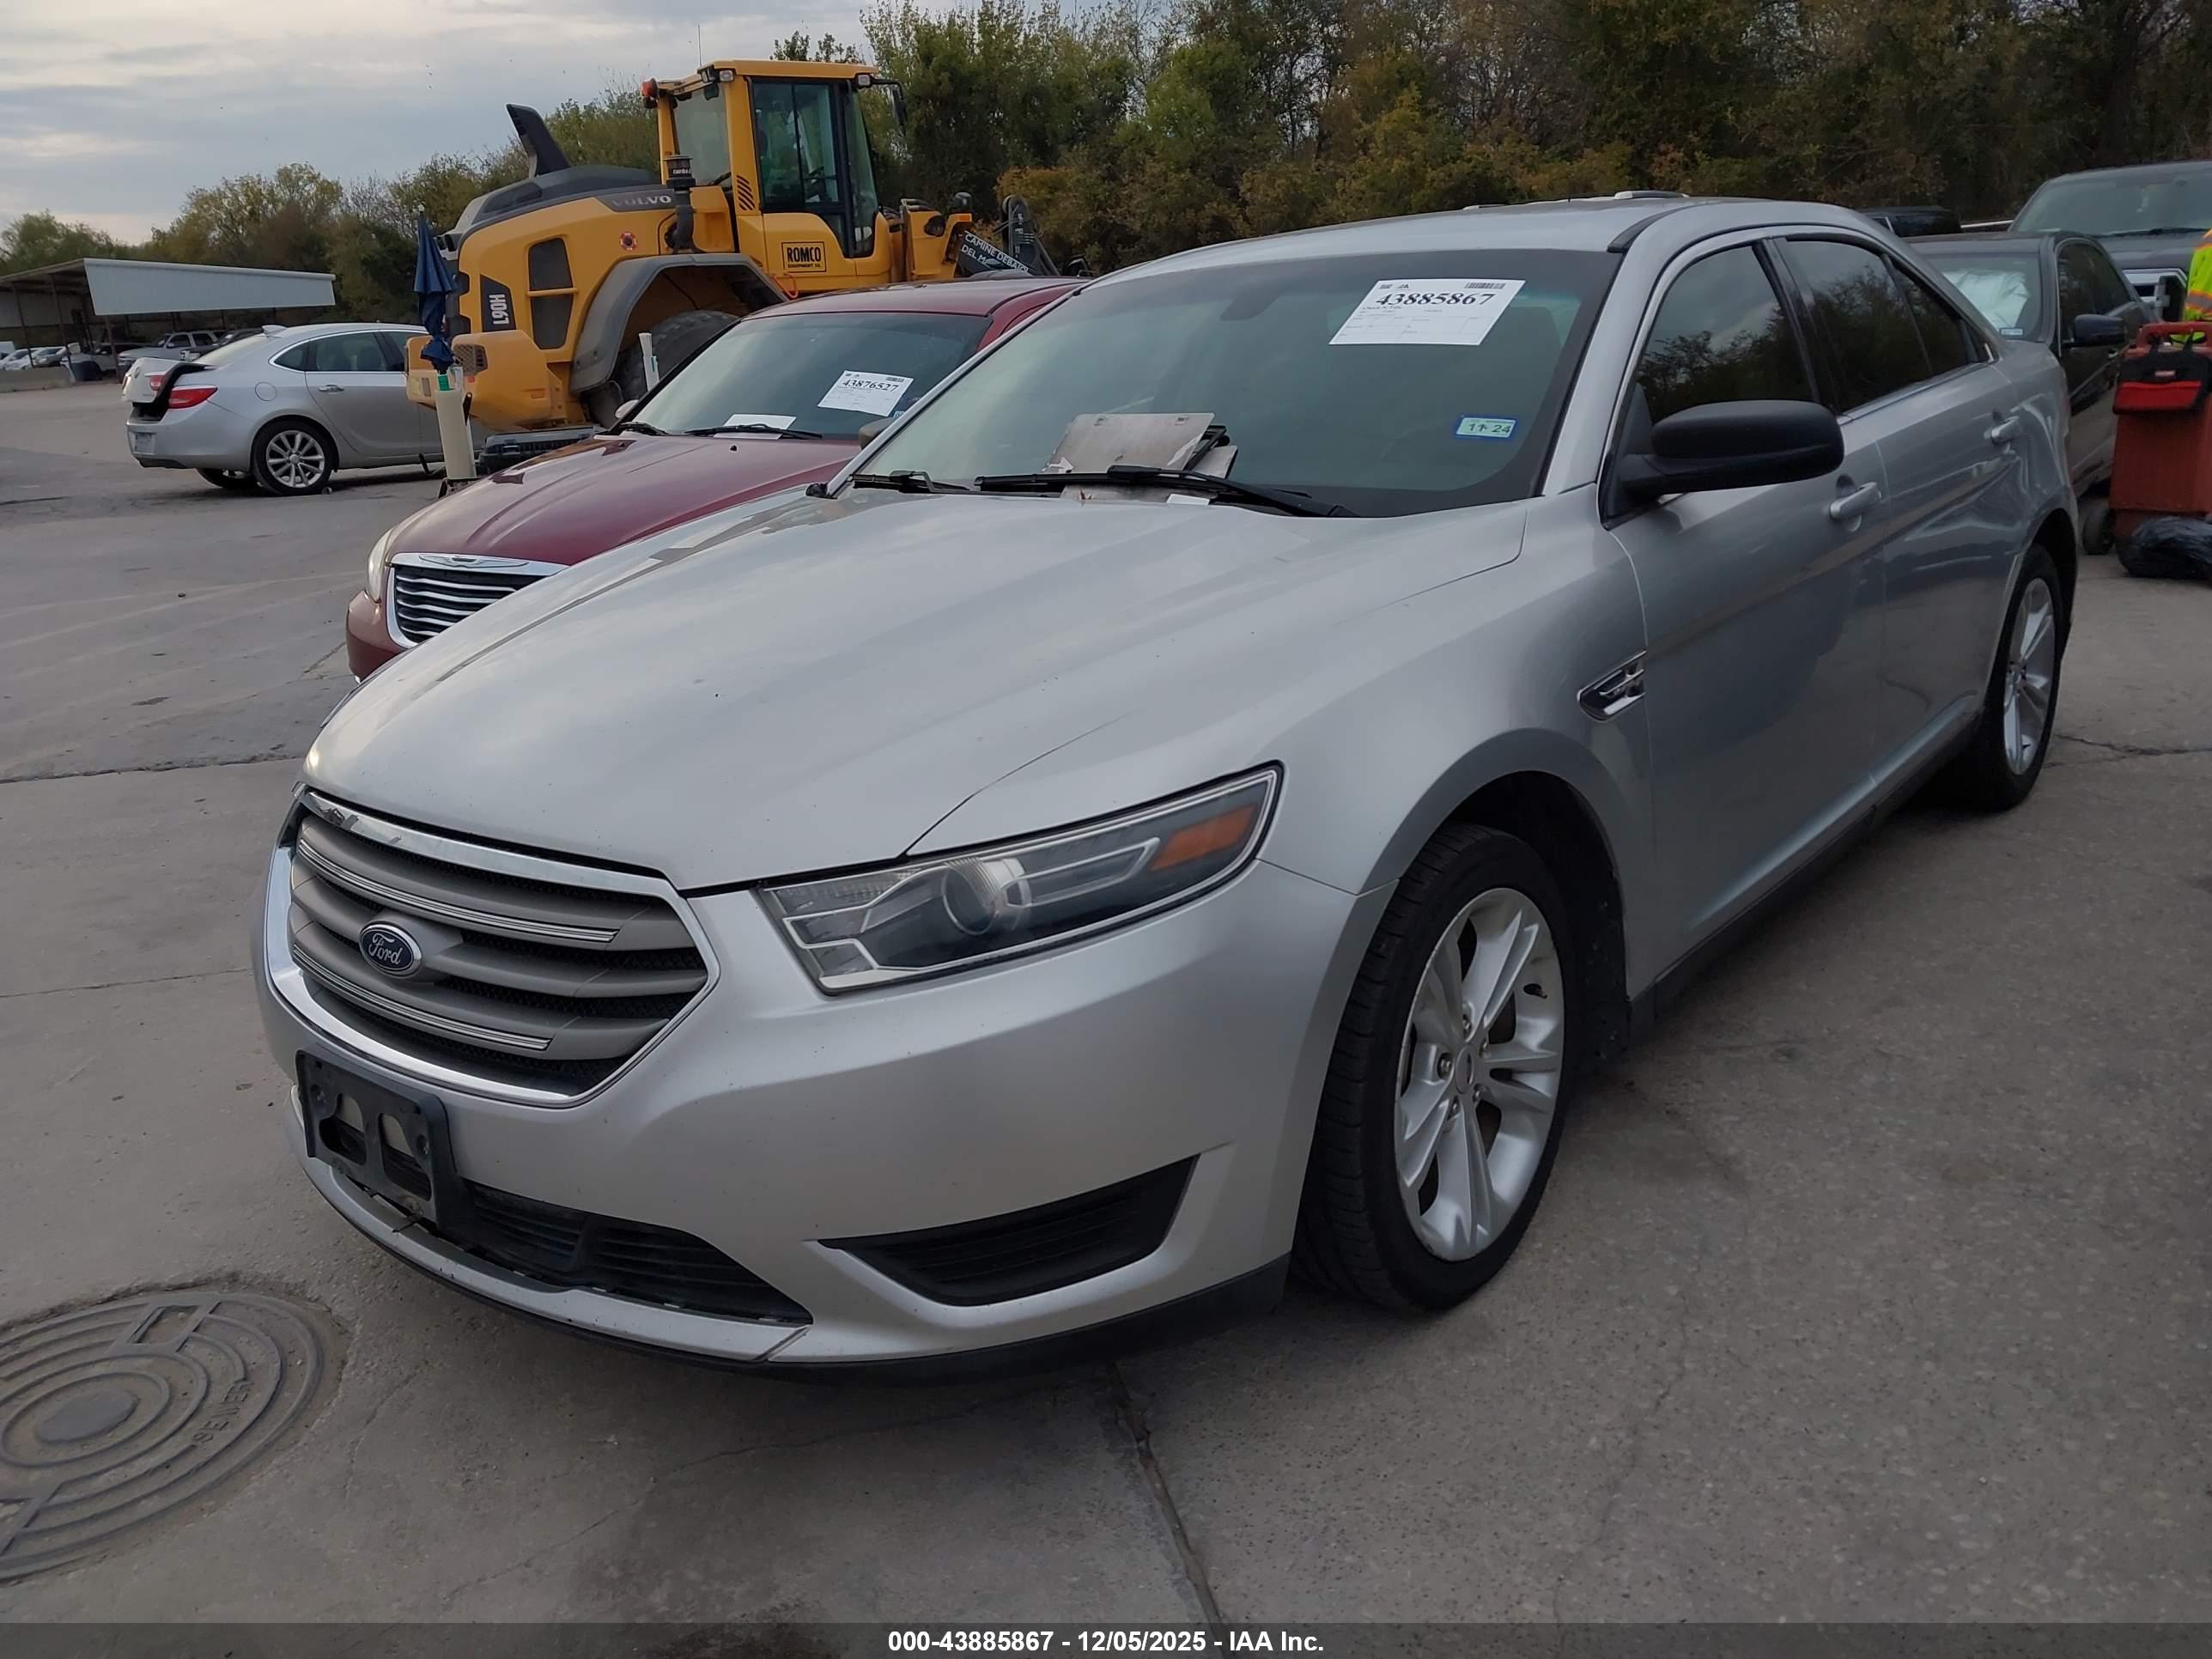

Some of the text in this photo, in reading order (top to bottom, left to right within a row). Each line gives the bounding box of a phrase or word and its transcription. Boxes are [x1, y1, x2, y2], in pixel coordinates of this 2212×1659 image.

[611, 195, 672, 207] VOLVO
[961, 244, 977, 258] DEL
[964, 233, 997, 257] CAMINE
[787, 246, 822, 263] ROMCO
[1376, 293, 1496, 306] 43885867
[489, 294, 510, 325] L90H
[842, 379, 900, 392] 43876527
[1491, 424, 1513, 434] 24
[368, 933, 404, 964] Ford
